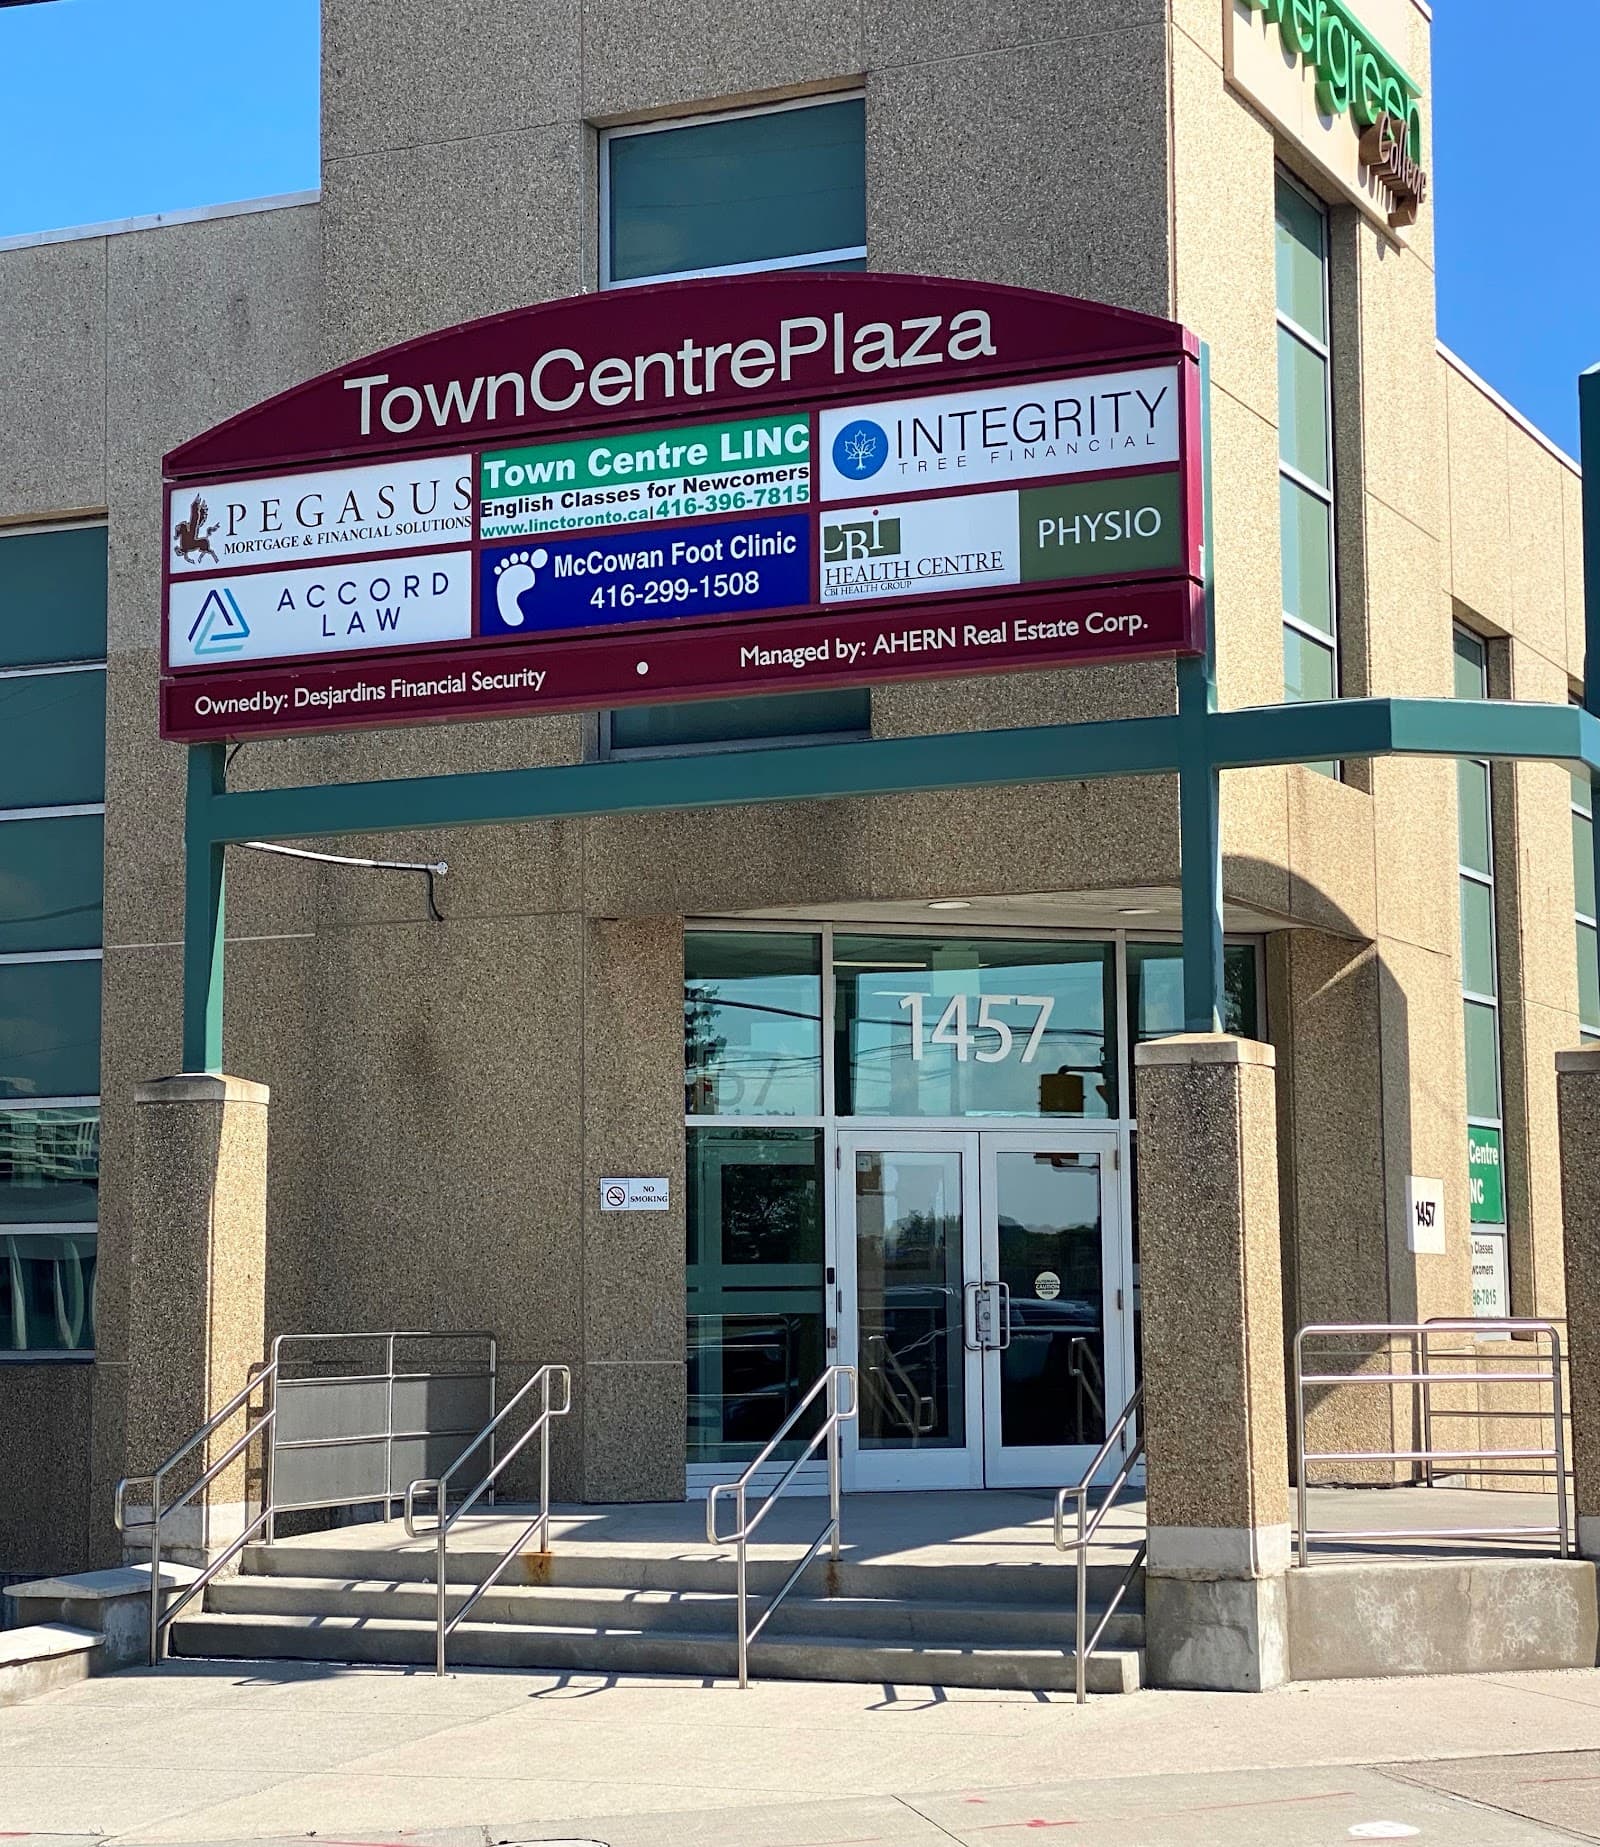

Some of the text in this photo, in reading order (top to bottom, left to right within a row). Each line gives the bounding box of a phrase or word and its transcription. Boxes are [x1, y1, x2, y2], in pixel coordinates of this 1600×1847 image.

[1256, 0, 1421, 168] ergreen
[898, 386, 1168, 458] INTEGRITY
[483, 424, 810, 489] Town Centre LINC
[898, 433, 1156, 474] TREE FINANCIAL
[225, 476, 471, 536] PEGASUS
[480, 464, 810, 519] English Classes for Newcomers
[656, 484, 810, 518] 416-396-7815
[223, 515, 472, 555] MORTGAGE & FINANCIAL SOLUTIONS
[1039, 507, 1162, 548] PHYSIO
[554, 531, 797, 578] McCowan Foot Clinic
[826, 551, 1003, 586] HEALTH CENTRE
[277, 572, 449, 612] ACCORD
[590, 570, 760, 609] 416-299-1508
[824, 580, 912, 597] CBI HEALTH GROUP
[322, 606, 401, 637] LAW
[740, 611, 1149, 669] Managed by: AHERN Real Estate Corp.
[294, 682, 386, 709] Desjardins
[391, 672, 467, 699] Financial
[471, 667, 547, 692] Security
[899, 993, 1055, 1064] 1457
[1469, 1139, 1499, 1165] Centre
[630, 1195, 668, 1203] SMOKING
[642, 1185, 655, 1193] NO
[1470, 1178, 1484, 1204] NC
[1415, 1200, 1436, 1228] 1457
[1472, 1265, 1494, 1276] wcomers
[1473, 1288, 1497, 1306] 96-7815
